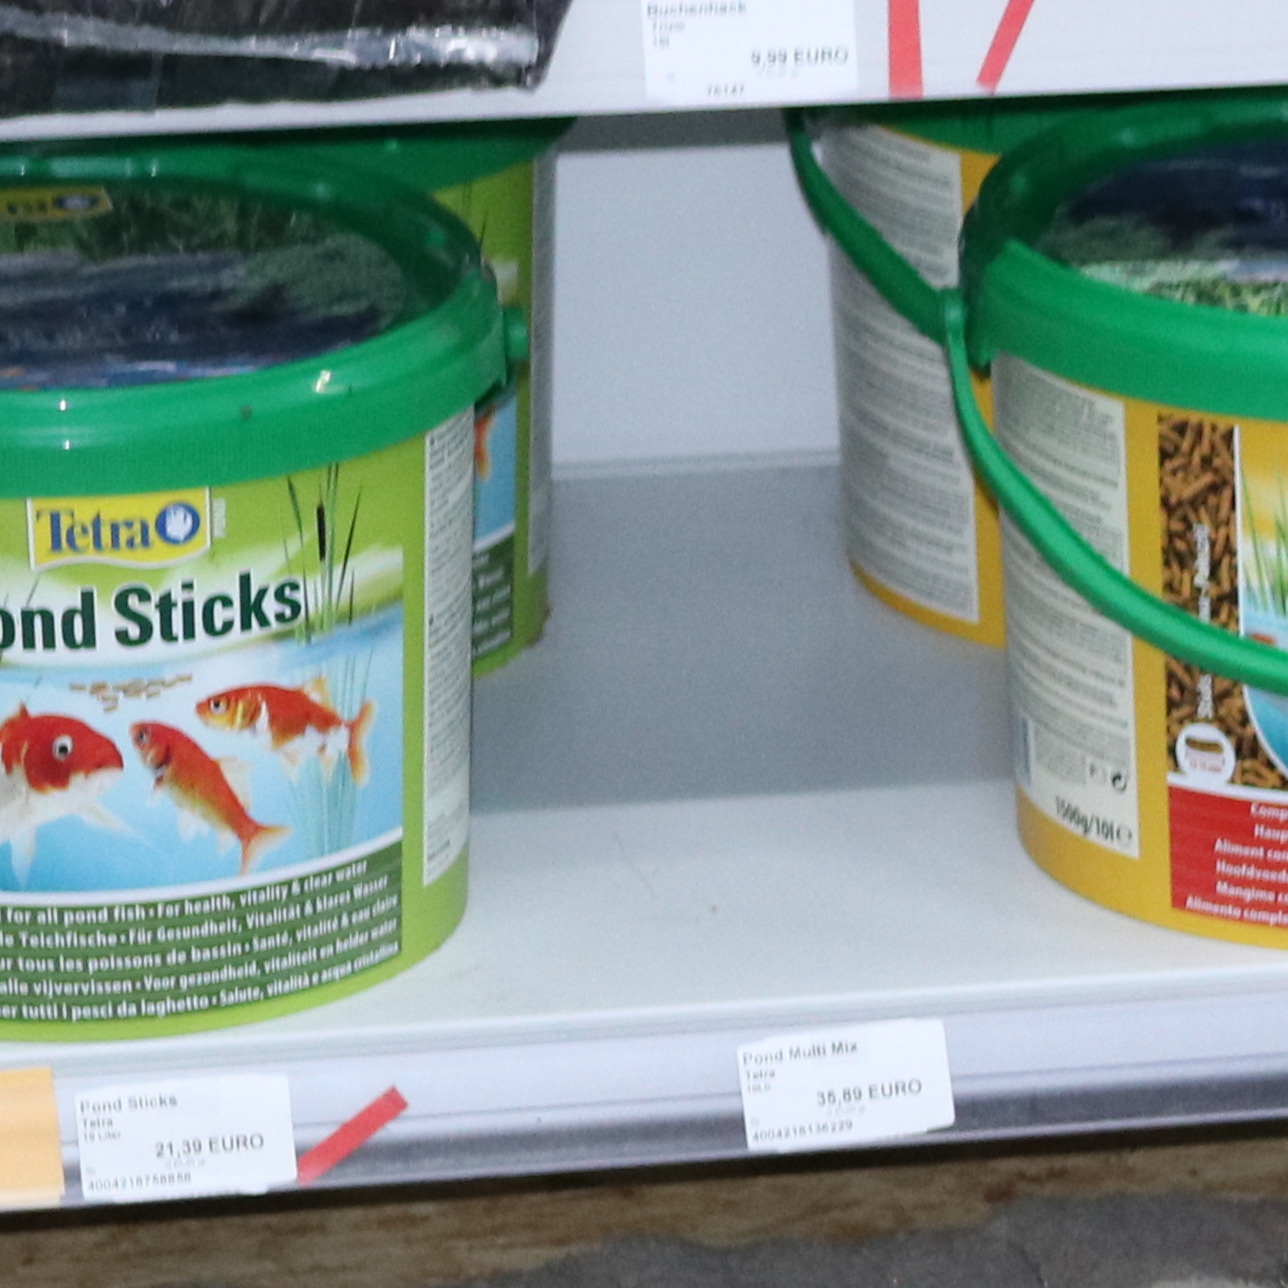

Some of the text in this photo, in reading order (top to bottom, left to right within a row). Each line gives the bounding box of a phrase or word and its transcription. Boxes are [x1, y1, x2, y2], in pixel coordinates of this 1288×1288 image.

[751, 46, 849, 67] 9,99 EURO
[36, 509, 154, 553] Tetra
[113, 571, 303, 647] Sticks
[1214, 837, 1264, 857] Aliment
[7, 906, 31, 924] for
[37, 905, 58, 924] all
[64, 905, 108, 928] pond
[114, 903, 146, 923] fish
[157, 901, 181, 919] For
[184, 894, 236, 916] health,
[239, 885, 289, 908] vitality
[303, 871, 333, 892] clear
[335, 859, 368, 883] water
[1216, 880, 1276, 902] Mangime
[19, 929, 118, 949] Teichfische
[129, 925, 152, 945] Für
[157, 916, 242, 941] Gesundheit,
[245, 902, 301, 929] Vitalität
[315, 889, 351, 912] klares
[352, 874, 388, 900] Wasser
[1186, 894, 1241, 920] Alimento
[18, 955, 54, 972] tous
[59, 954, 83, 972] les
[88, 948, 162, 976] poissons
[166, 947, 187, 966] de
[191, 940, 242, 963] bassin
[252, 929, 293, 952] Santé,
[295, 916, 339, 943] vitalité
[351, 905, 371, 925] eau
[33, 977, 133, 999] vijvervissen
[143, 973, 176, 991] Voor
[179, 959, 261, 992] gezondheid,
[263, 946, 317, 974] vitaliteit
[319, 942, 334, 961] en
[336, 929, 369, 953] helder
[22, 1001, 58, 1020] tutti
[71, 1000, 114, 1023] pesci
[116, 998, 137, 1018] da
[141, 993, 209, 1019] laghetto
[219, 984, 264, 1008] Salute,
[266, 969, 310, 998] vitalità
[311, 970, 319, 986] e
[321, 957, 352, 982] acqua
[742, 1039, 858, 1067] Pond Multi Mix
[746, 1069, 776, 1081] Tetra
[868, 1077, 923, 1099] EURO
[79, 1094, 178, 1114] Pond Sticks
[82, 1117, 114, 1130] Tetra
[154, 1132, 265, 1160] 21,39 EURO
